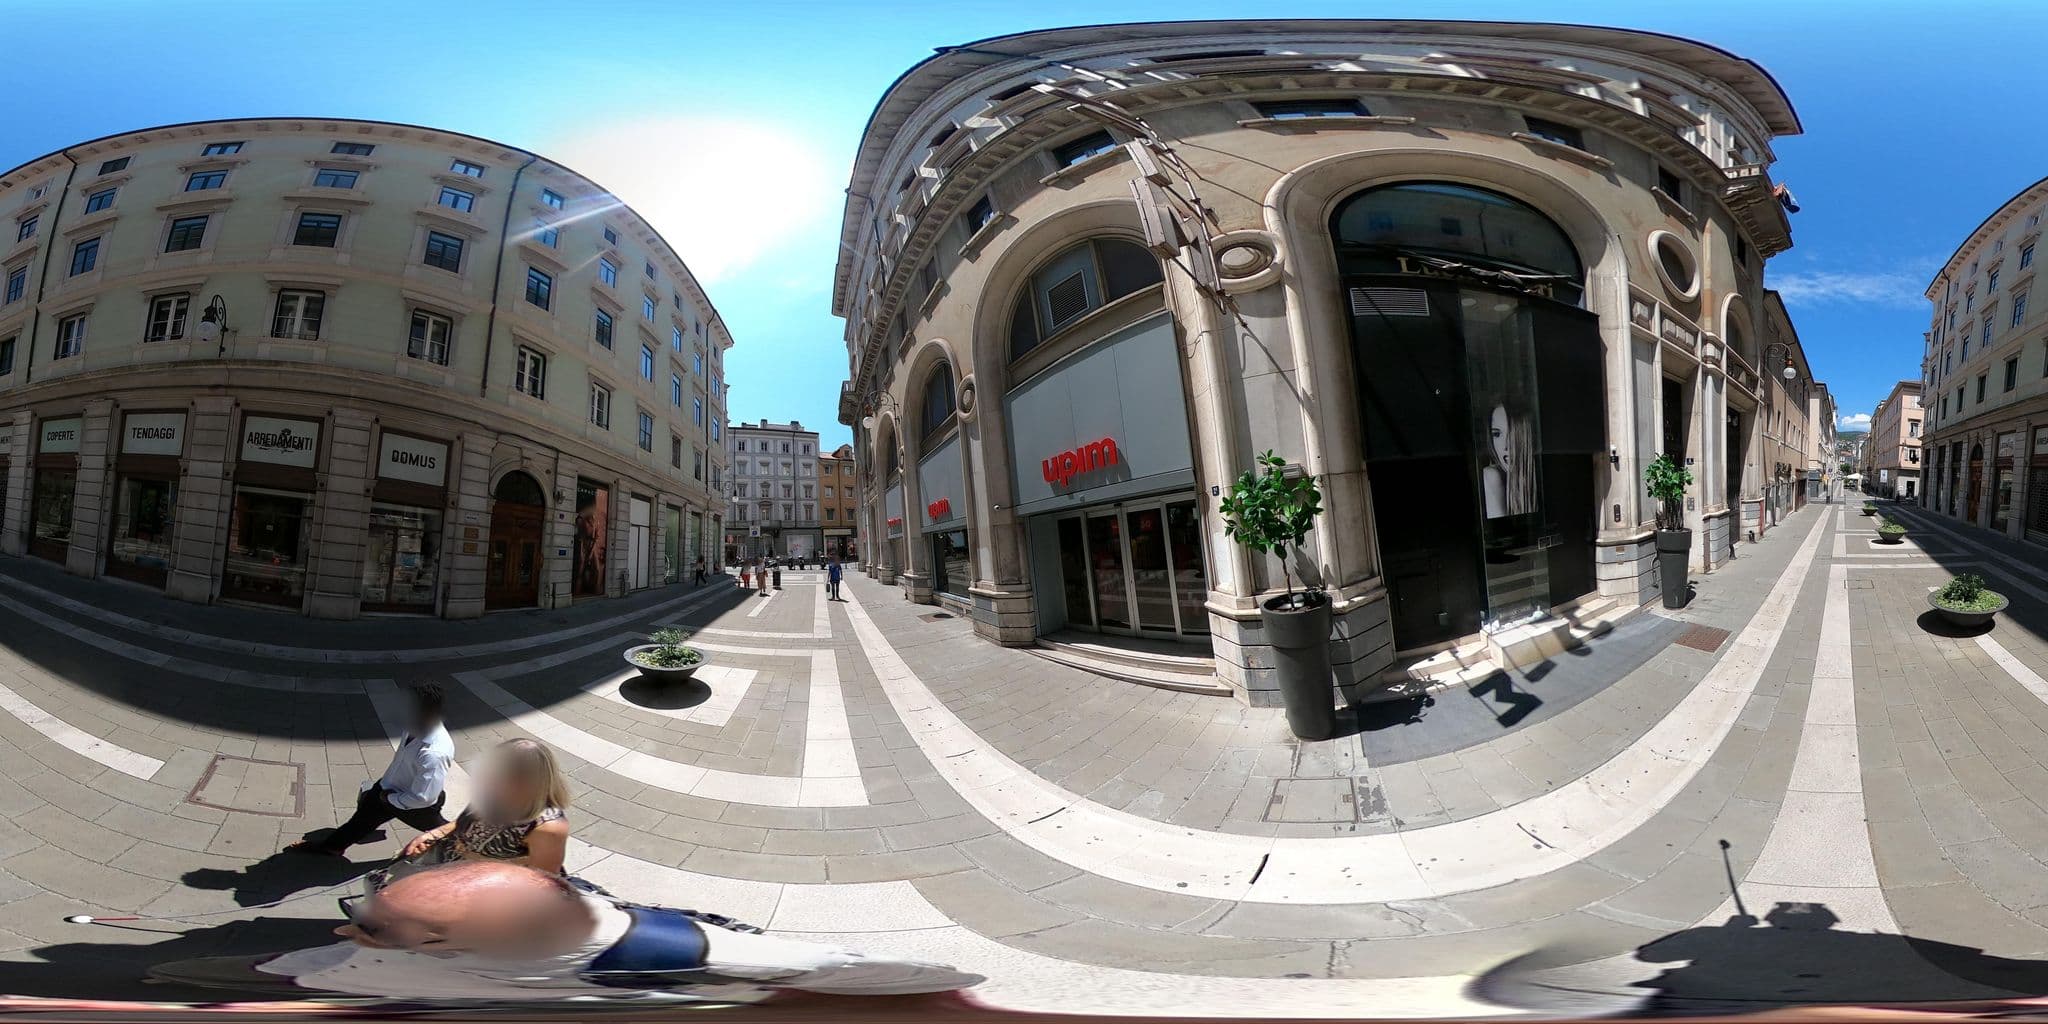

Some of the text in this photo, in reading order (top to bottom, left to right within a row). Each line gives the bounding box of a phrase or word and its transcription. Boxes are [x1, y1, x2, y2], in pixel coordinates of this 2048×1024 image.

[46, 430, 75, 442] COPERTE
[132, 427, 176, 440] TENDAGGI
[246, 431, 313, 451] ARREDAMENTI
[391, 449, 437, 469] DOMUS
[1041, 436, 1119, 488] upim
[928, 497, 949, 520] upim
